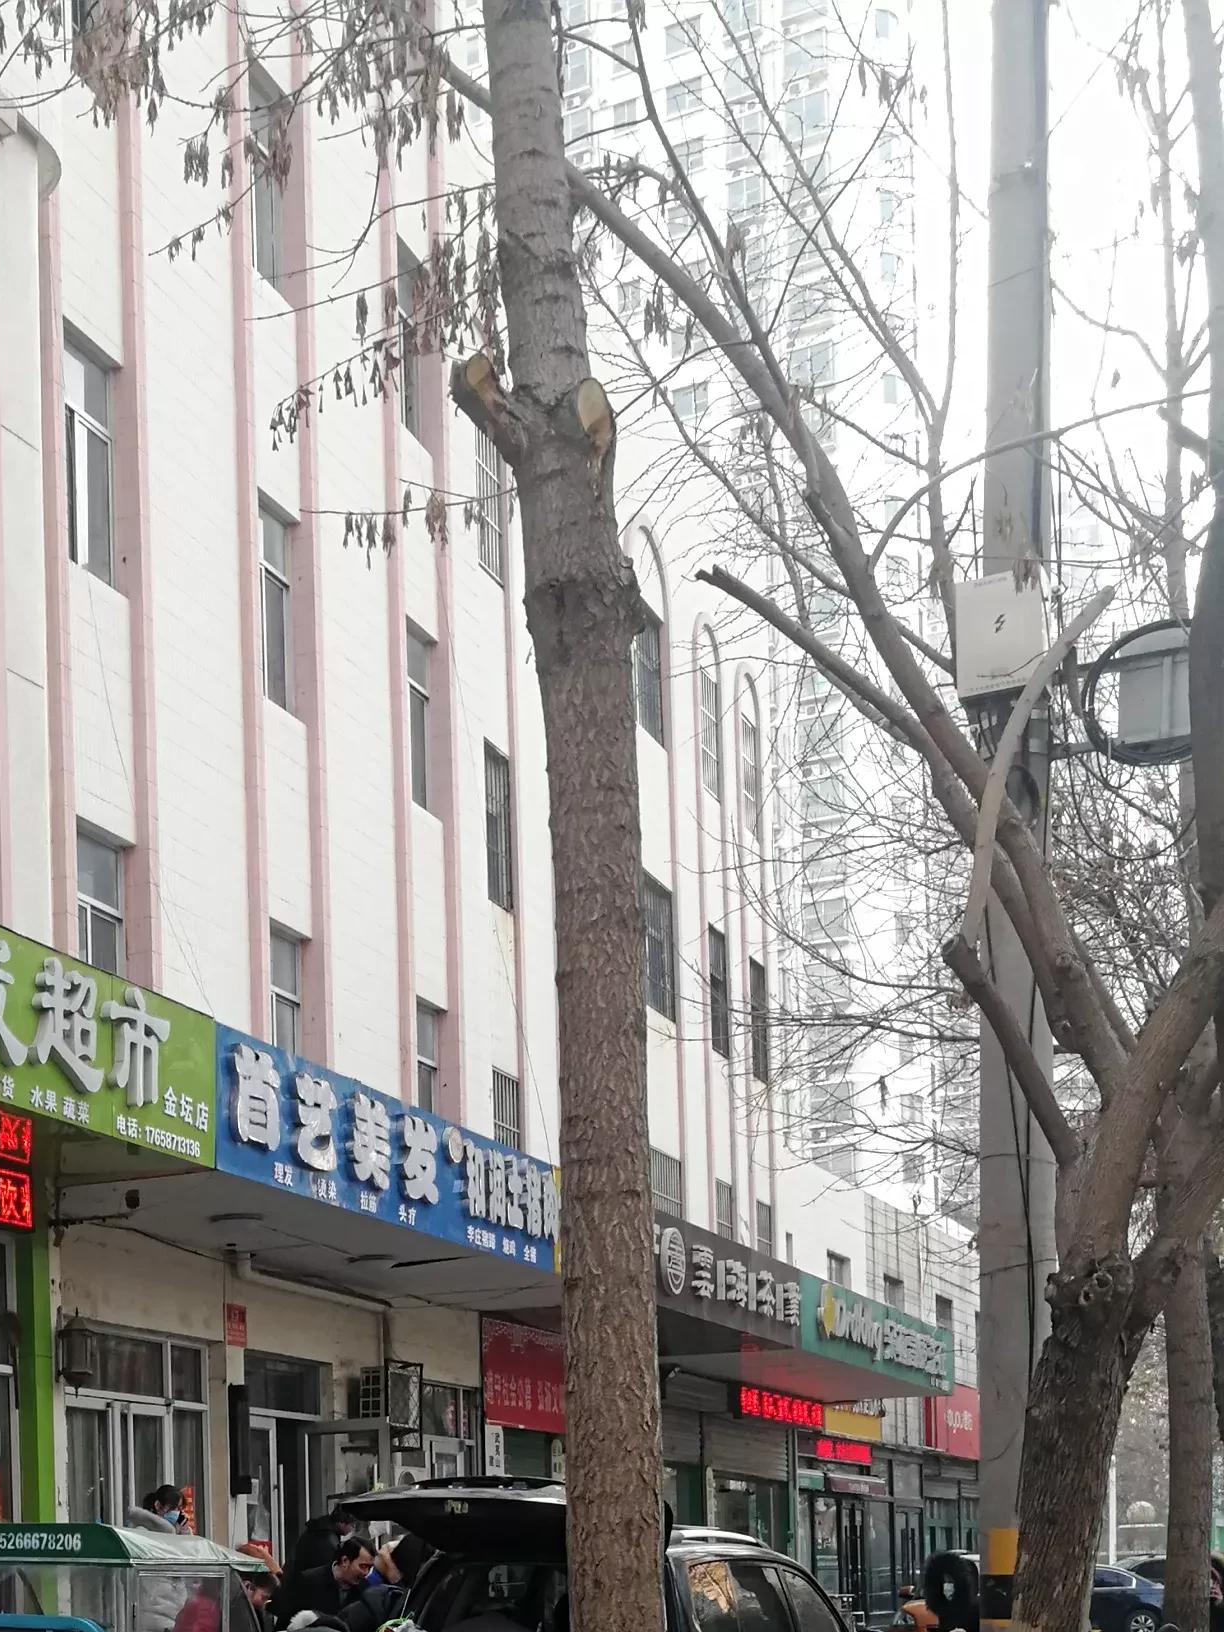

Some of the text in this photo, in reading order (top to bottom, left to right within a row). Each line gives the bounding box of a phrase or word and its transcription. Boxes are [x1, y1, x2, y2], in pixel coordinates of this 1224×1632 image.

[30, 1085, 58, 1113] 水果
[62, 1095, 90, 1125] 蔬菜
[163, 1085, 209, 1133] 金坛店
[273, 1161, 294, 1188] 理发
